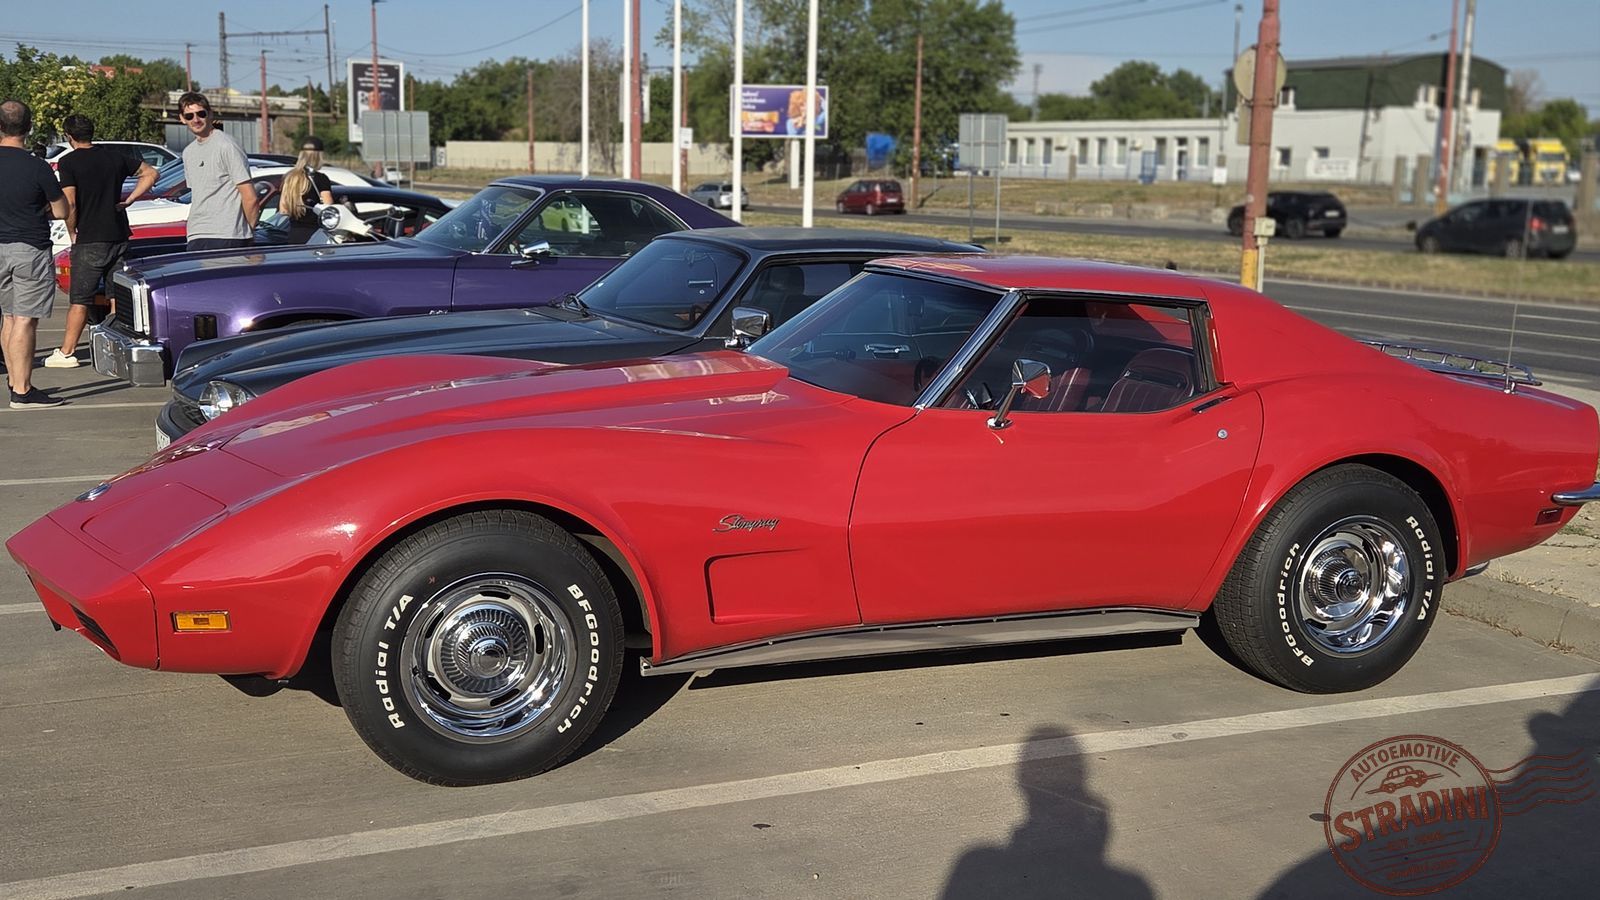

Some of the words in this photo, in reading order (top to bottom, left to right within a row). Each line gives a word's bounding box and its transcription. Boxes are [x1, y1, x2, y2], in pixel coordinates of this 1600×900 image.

[1405, 515, 1434, 580] Radial
[384, 594, 414, 631] T/A
[1277, 542, 1315, 667] BFGoodrich
[1416, 589, 1433, 621] T/A
[375, 641, 406, 729] Radial
[557, 583, 600, 734] BFGoodrich
